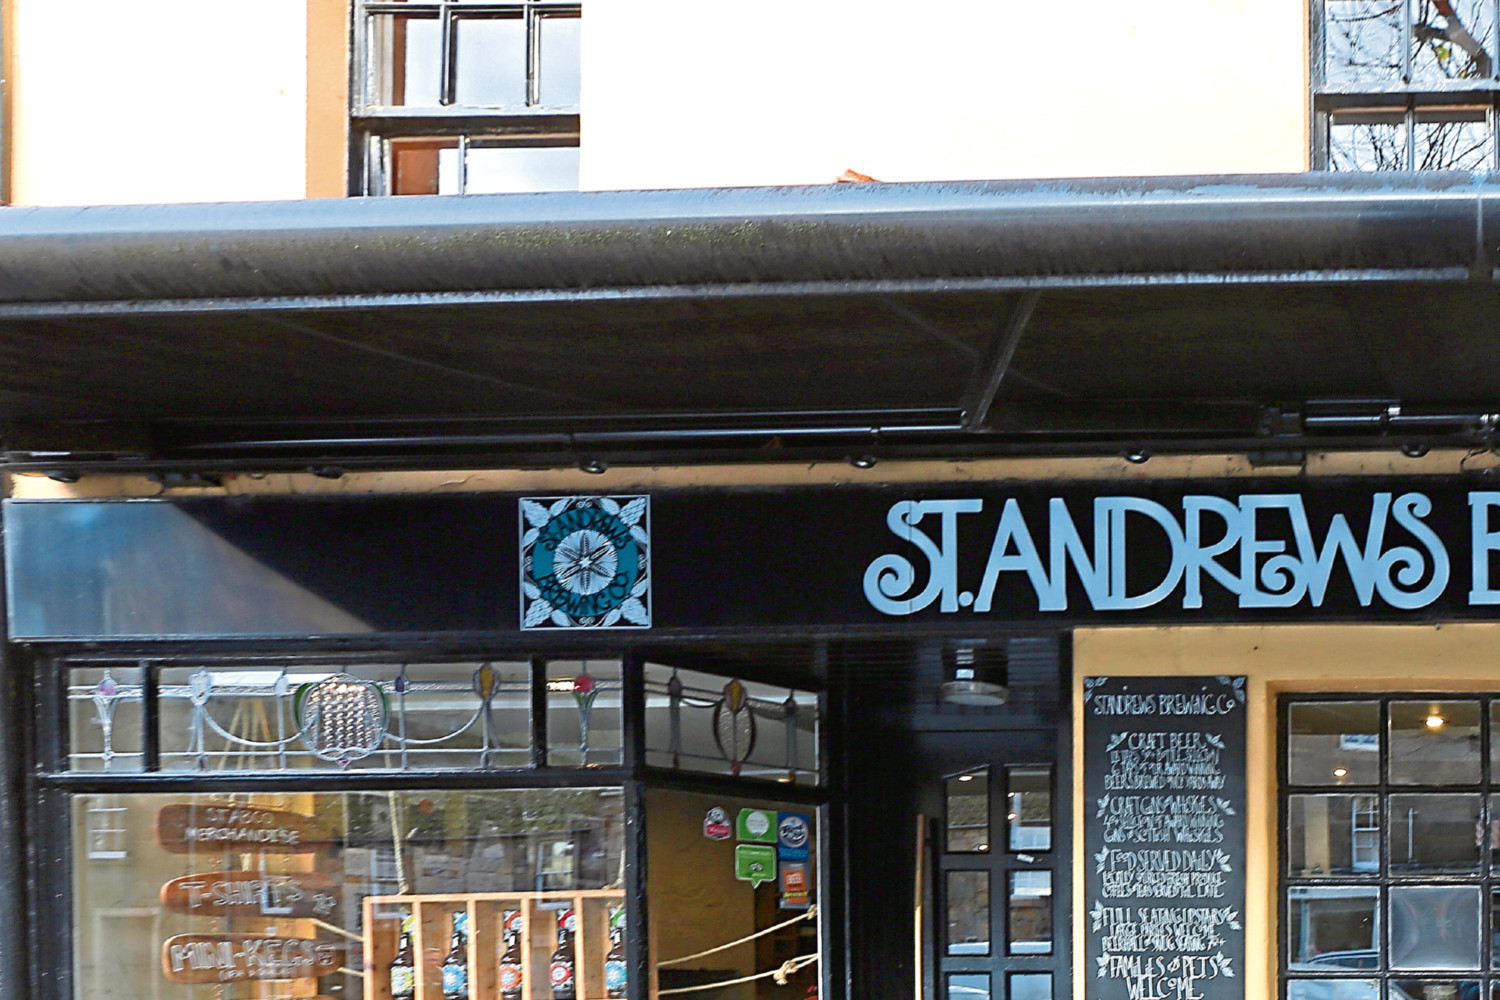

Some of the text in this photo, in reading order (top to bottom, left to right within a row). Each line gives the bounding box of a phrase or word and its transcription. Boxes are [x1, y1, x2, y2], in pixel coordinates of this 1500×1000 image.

[1128, 732, 1207, 749] CRAFT BEER
[184, 826, 300, 845] MERCHANDISE
[1138, 849, 1182, 872] SERVED
[1182, 849, 1216, 872] DAILY
[179, 878, 303, 909] T-SHIRTS
[170, 938, 315, 973] MINI-KEGS
[1110, 955, 1166, 979] FAMILIES
[1181, 955, 1219, 979] PETS
[1126, 976, 1205, 1000] WELCOME
